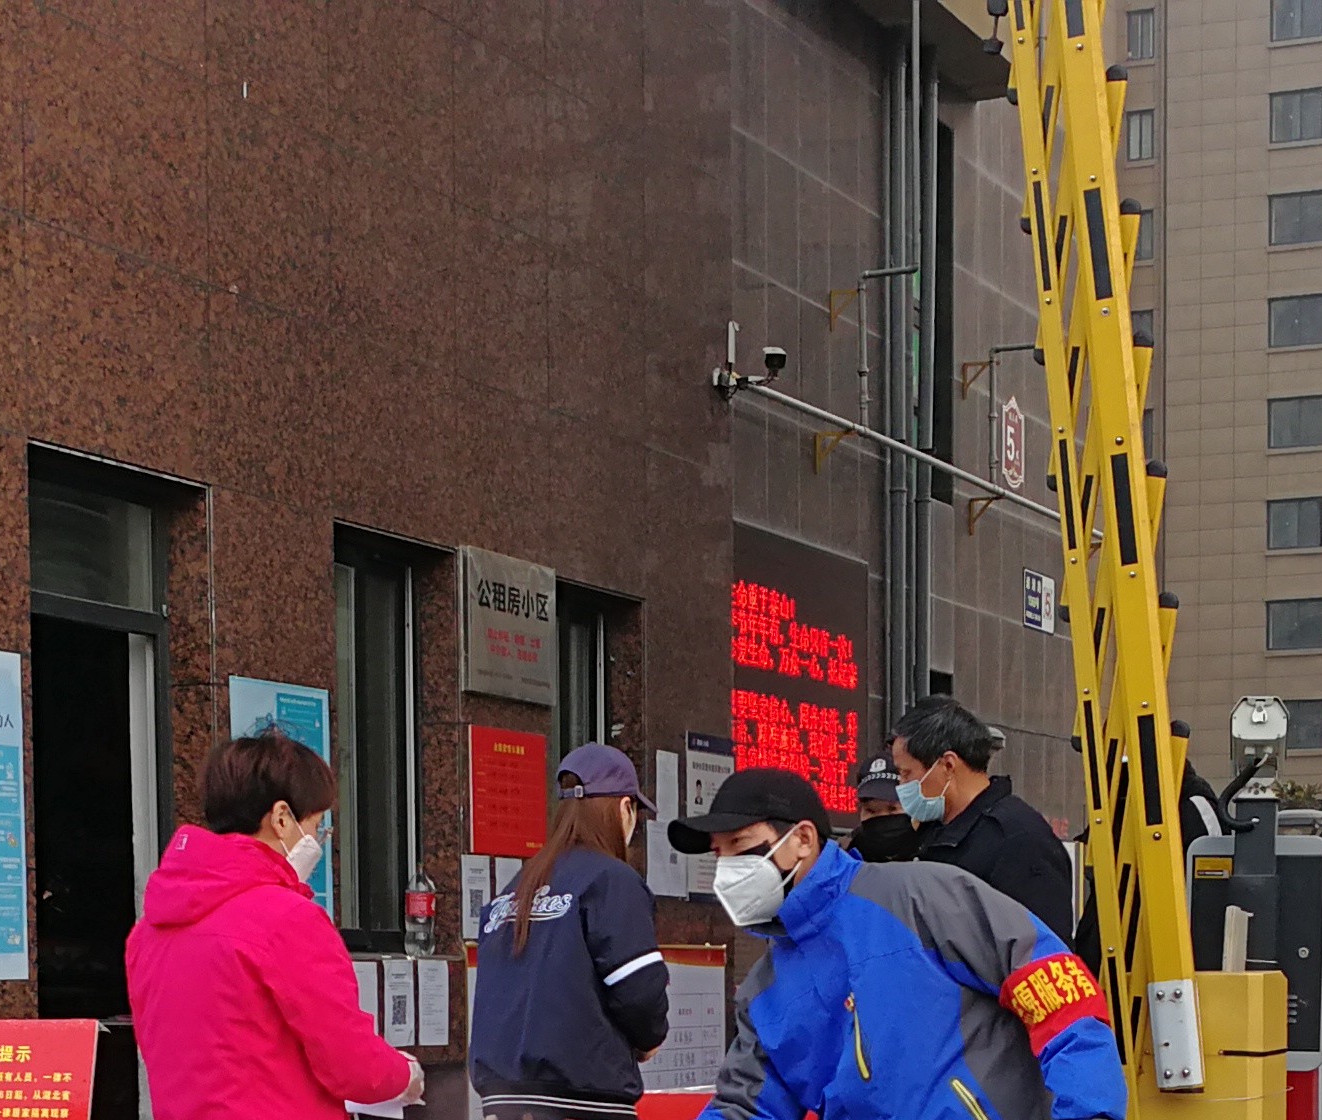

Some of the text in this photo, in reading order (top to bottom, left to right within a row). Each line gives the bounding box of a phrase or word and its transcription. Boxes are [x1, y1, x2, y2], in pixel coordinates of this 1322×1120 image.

[476, 577, 550, 622] 公租房小区
